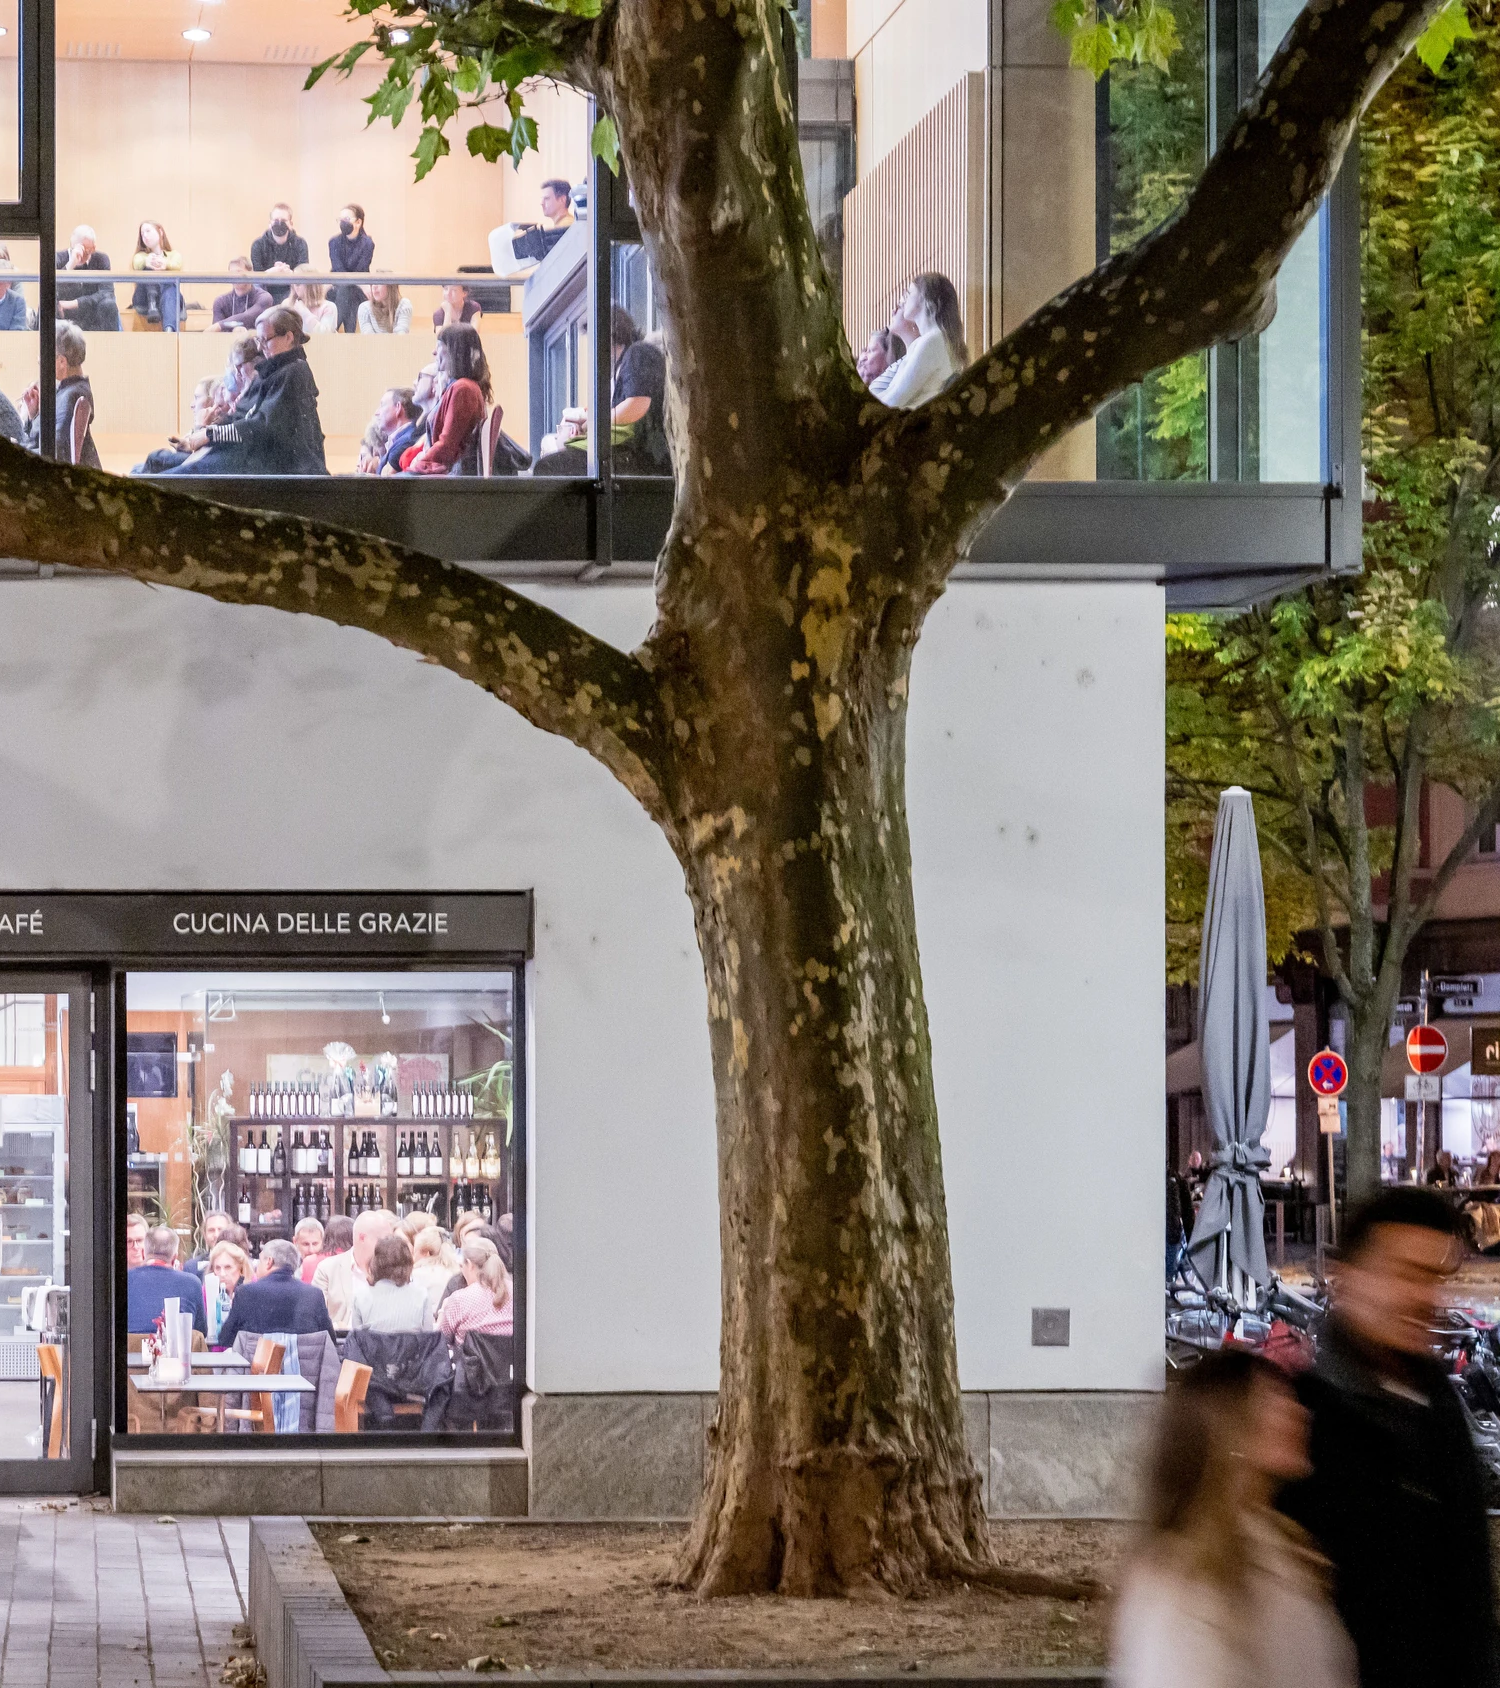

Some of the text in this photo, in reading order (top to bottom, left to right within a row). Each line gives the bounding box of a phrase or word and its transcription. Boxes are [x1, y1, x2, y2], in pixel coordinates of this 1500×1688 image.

[173, 912, 449, 935] CUCINA DELLE GRAZIE
